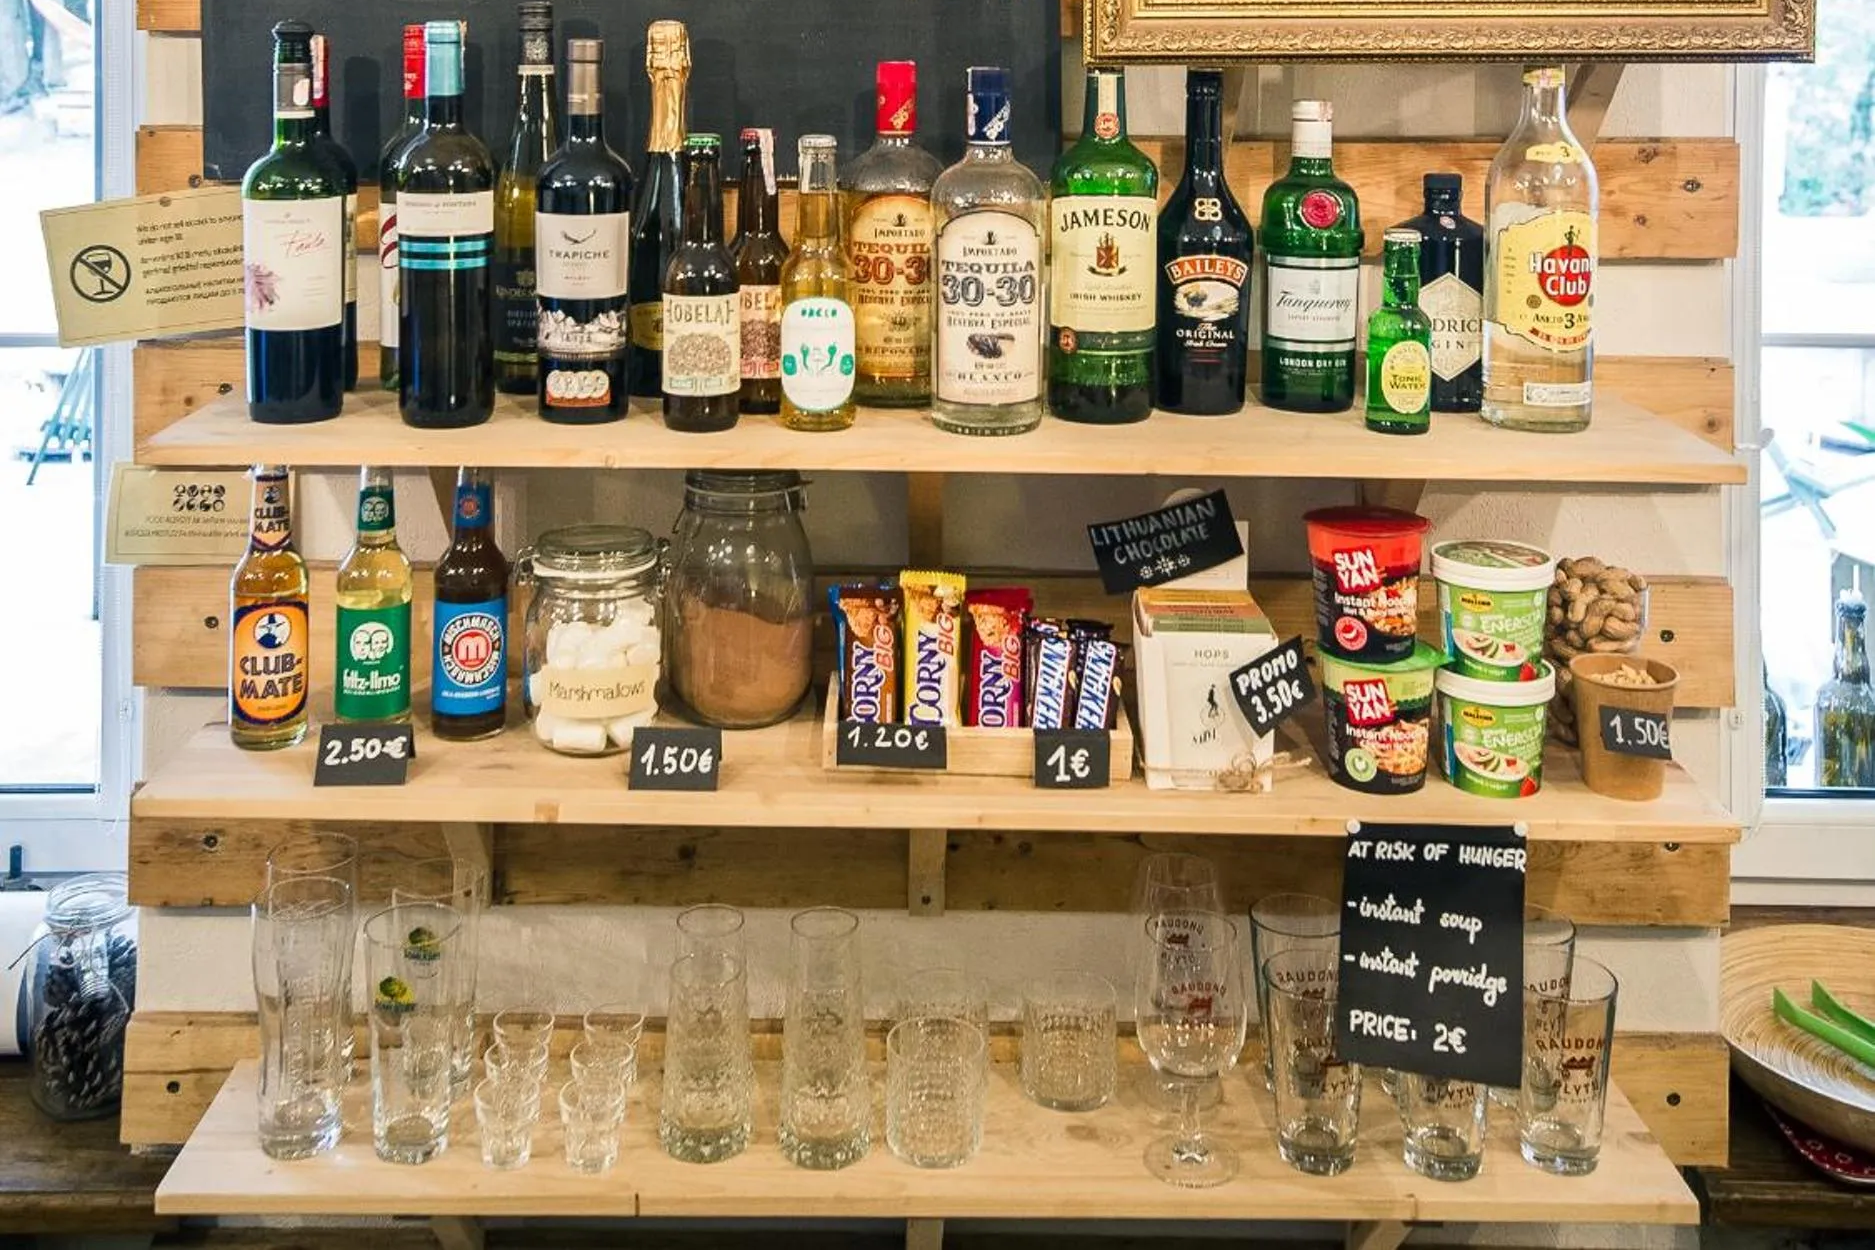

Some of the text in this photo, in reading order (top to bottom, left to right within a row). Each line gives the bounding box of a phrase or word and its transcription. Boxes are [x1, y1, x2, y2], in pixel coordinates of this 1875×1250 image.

[1060, 208, 1150, 232] JAMESON
[549, 250, 610, 259] TRAPICHE
[854, 241, 930, 254] TEQUIL
[854, 255, 930, 285] 30-3
[942, 259, 1035, 274] TEQUILA
[1170, 260, 1244, 279] BAILEYS
[942, 274, 1035, 307] 30-30
[1546, 276, 1587, 295] Club
[674, 303, 724, 325] OBELA
[1565, 313, 1575, 329] 3
[1176, 330, 1235, 339] ORIGINAL
[1091, 498, 1216, 547] LITHUANIAN
[1114, 522, 1210, 565] CHOCOLATE
[1333, 549, 1374, 571] SUN
[1337, 566, 1379, 590] YAN
[936, 612, 955, 655] BIG
[874, 624, 894, 671] BIG
[1001, 635, 1021, 681] BIG
[1194, 650, 1230, 660] HOPS
[240, 672, 303, 699] MATE
[850, 641, 884, 723] ORNY
[1033, 639, 1071, 728] SNICKER
[1236, 648, 1298, 696] PROMO
[550, 680, 645, 700] Marshmallows
[979, 650, 1013, 727] ORNY
[1344, 681, 1384, 703] SUN
[1349, 701, 1391, 721] YAN
[1047, 745, 1090, 782] 1€
[1348, 841, 1527, 873] AT RISK OF HUNGER
[1440, 911, 1483, 944] soup
[1433, 1023, 1467, 1054] 2€
